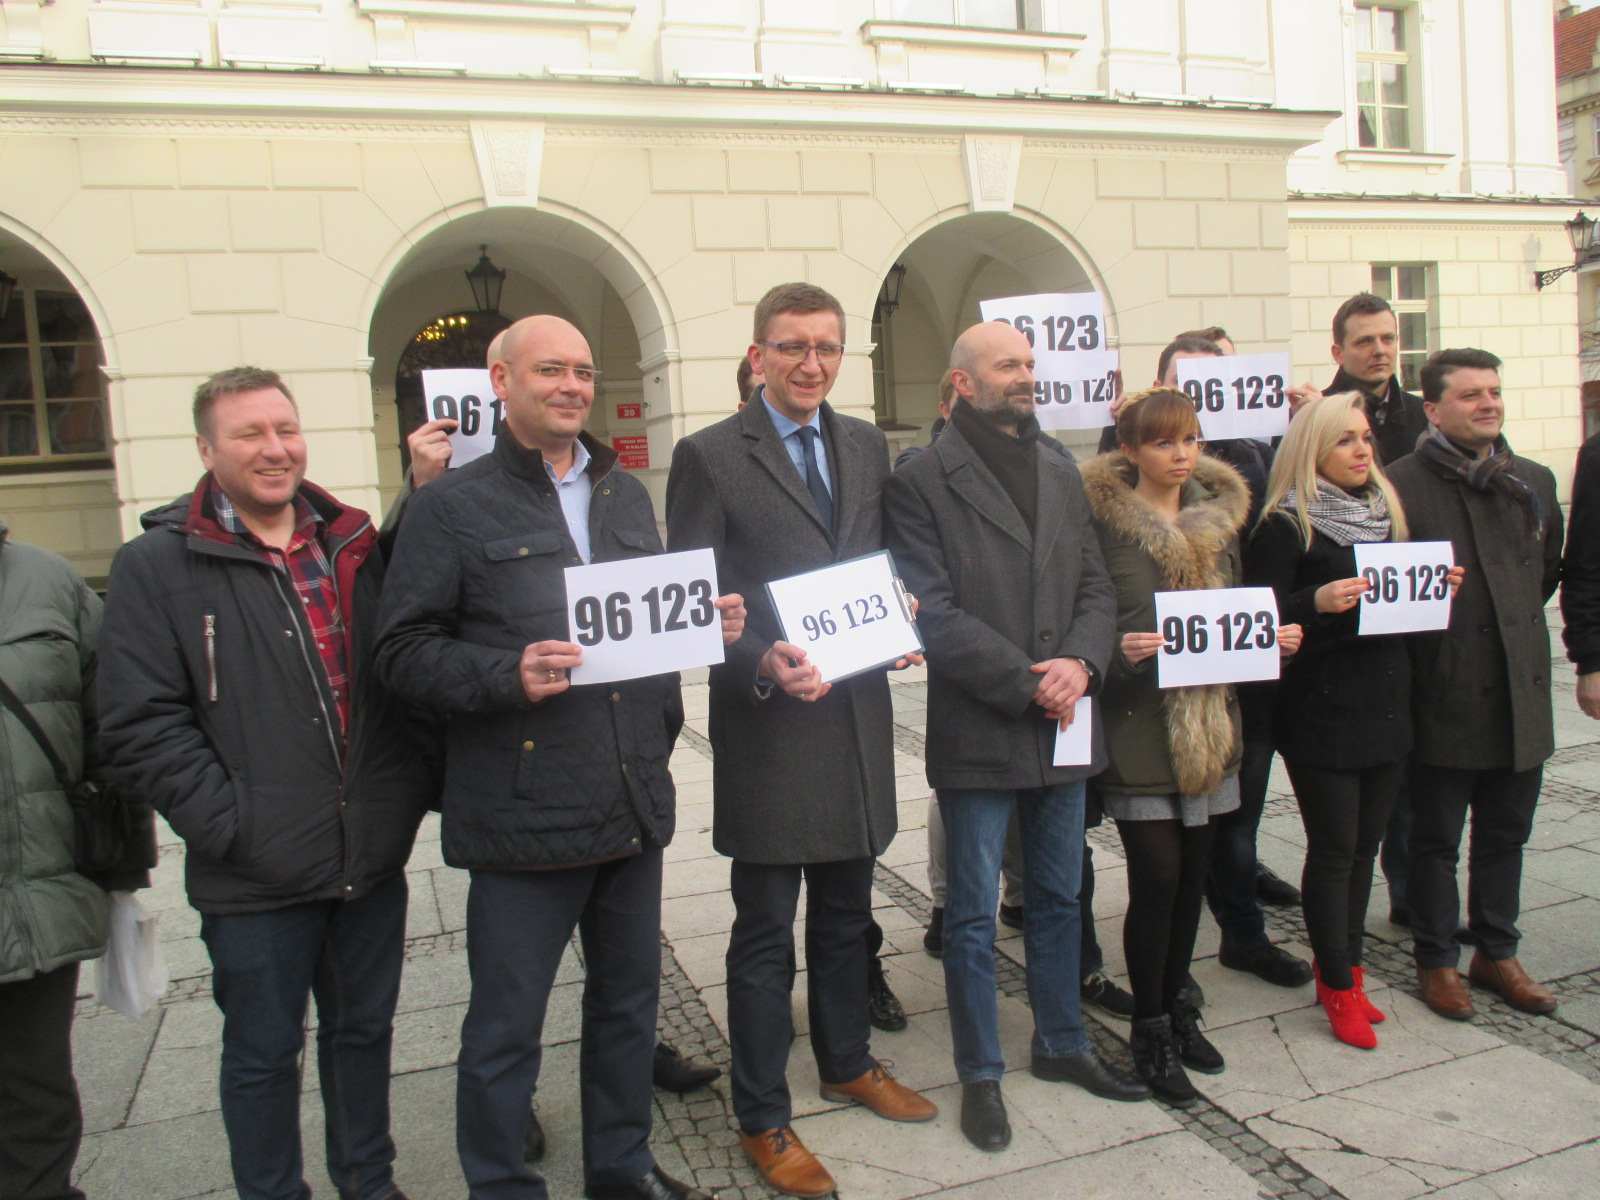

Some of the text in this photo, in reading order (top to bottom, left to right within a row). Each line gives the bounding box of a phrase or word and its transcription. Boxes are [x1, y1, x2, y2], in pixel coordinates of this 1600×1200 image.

[1042, 314, 1099, 351] 123
[1182, 374, 1284, 413] 96 123
[433, 394, 482, 436] 96
[1363, 564, 1450, 604] 96 123
[575, 578, 715, 647] 96 123
[802, 593, 889, 641] 96 123
[1163, 610, 1275, 655] 96 123
